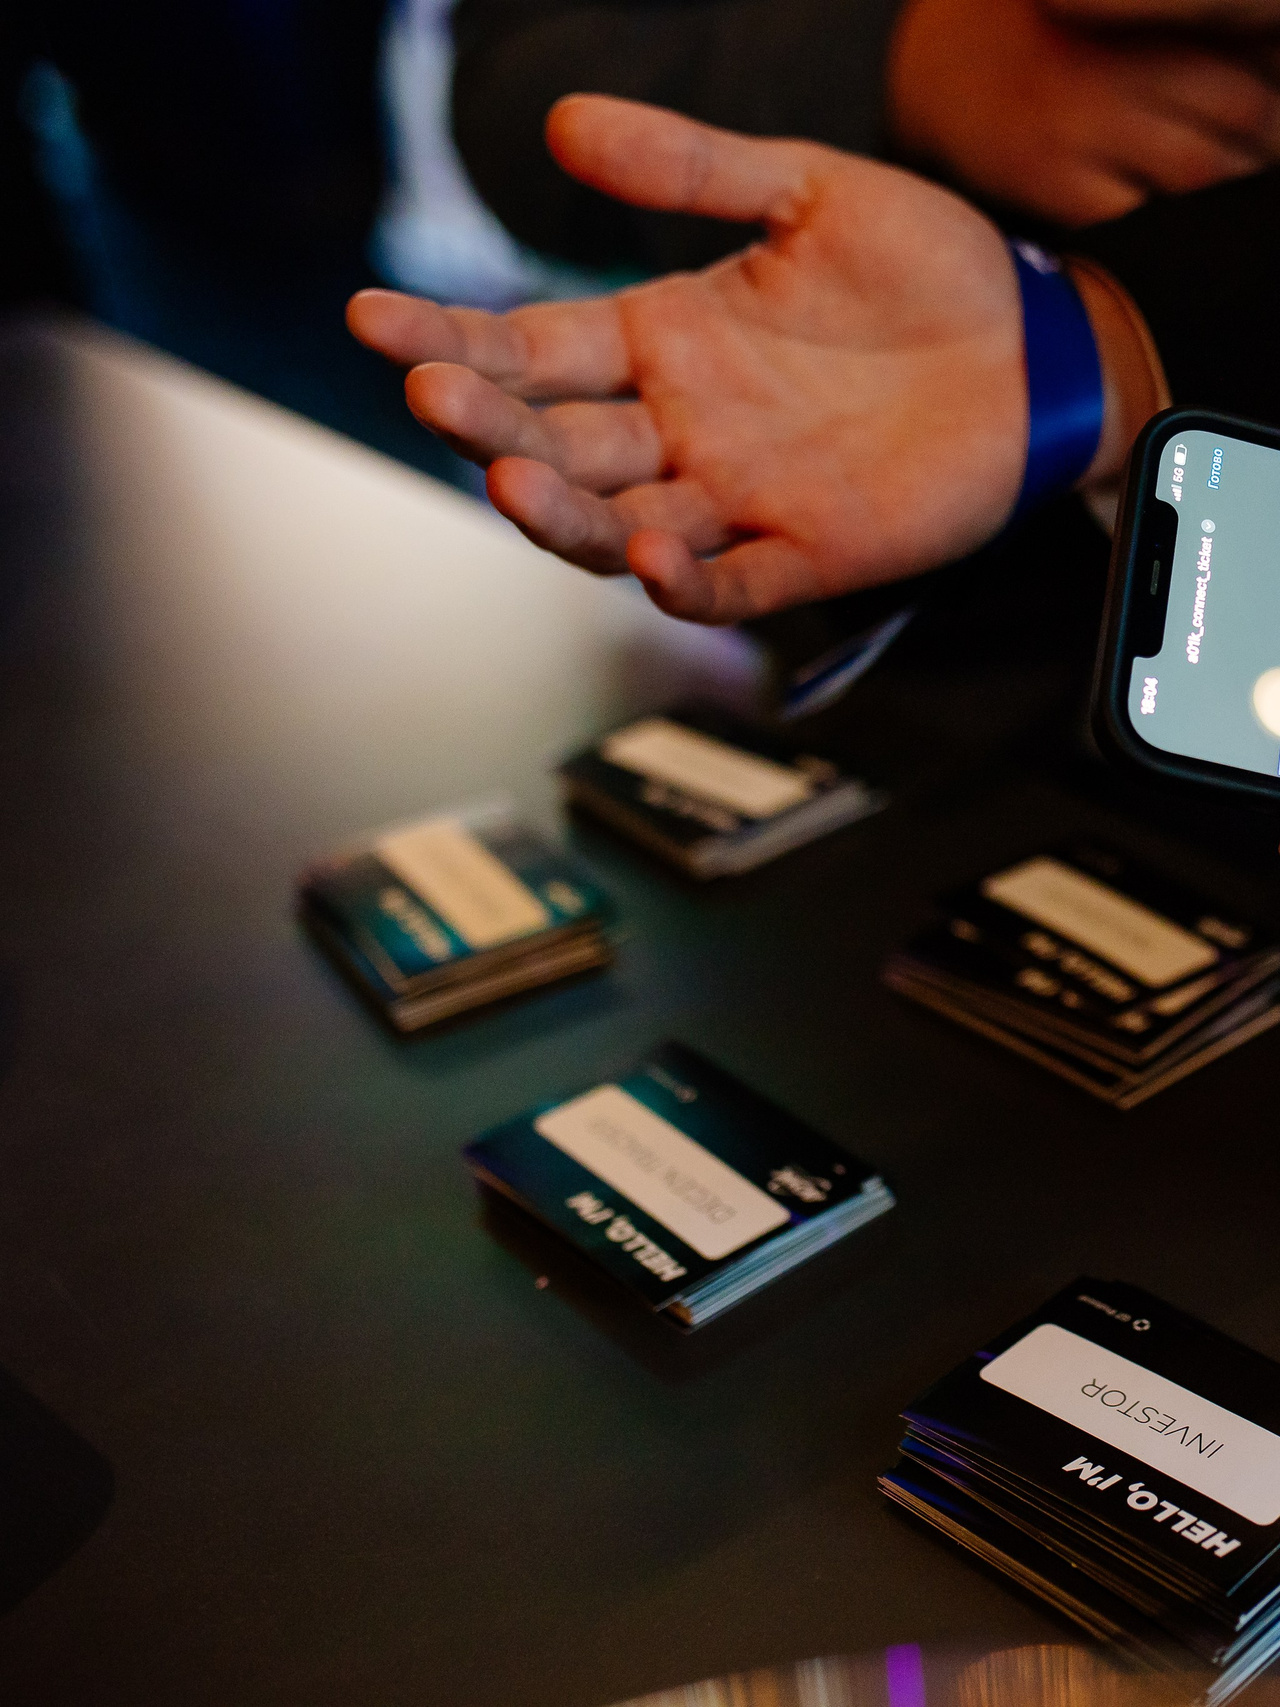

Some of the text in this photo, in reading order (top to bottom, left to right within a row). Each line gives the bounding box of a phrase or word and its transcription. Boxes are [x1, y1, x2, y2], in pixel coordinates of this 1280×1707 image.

[1172, 467, 1185, 484] 5G
[1207, 447, 1224, 490] Готово
[1186, 536, 1213, 664] a01k_connect_ticket
[1081, 1378, 1224, 1459] INVESTOR
[1062, 1455, 1242, 1558] HELLO, I'M
